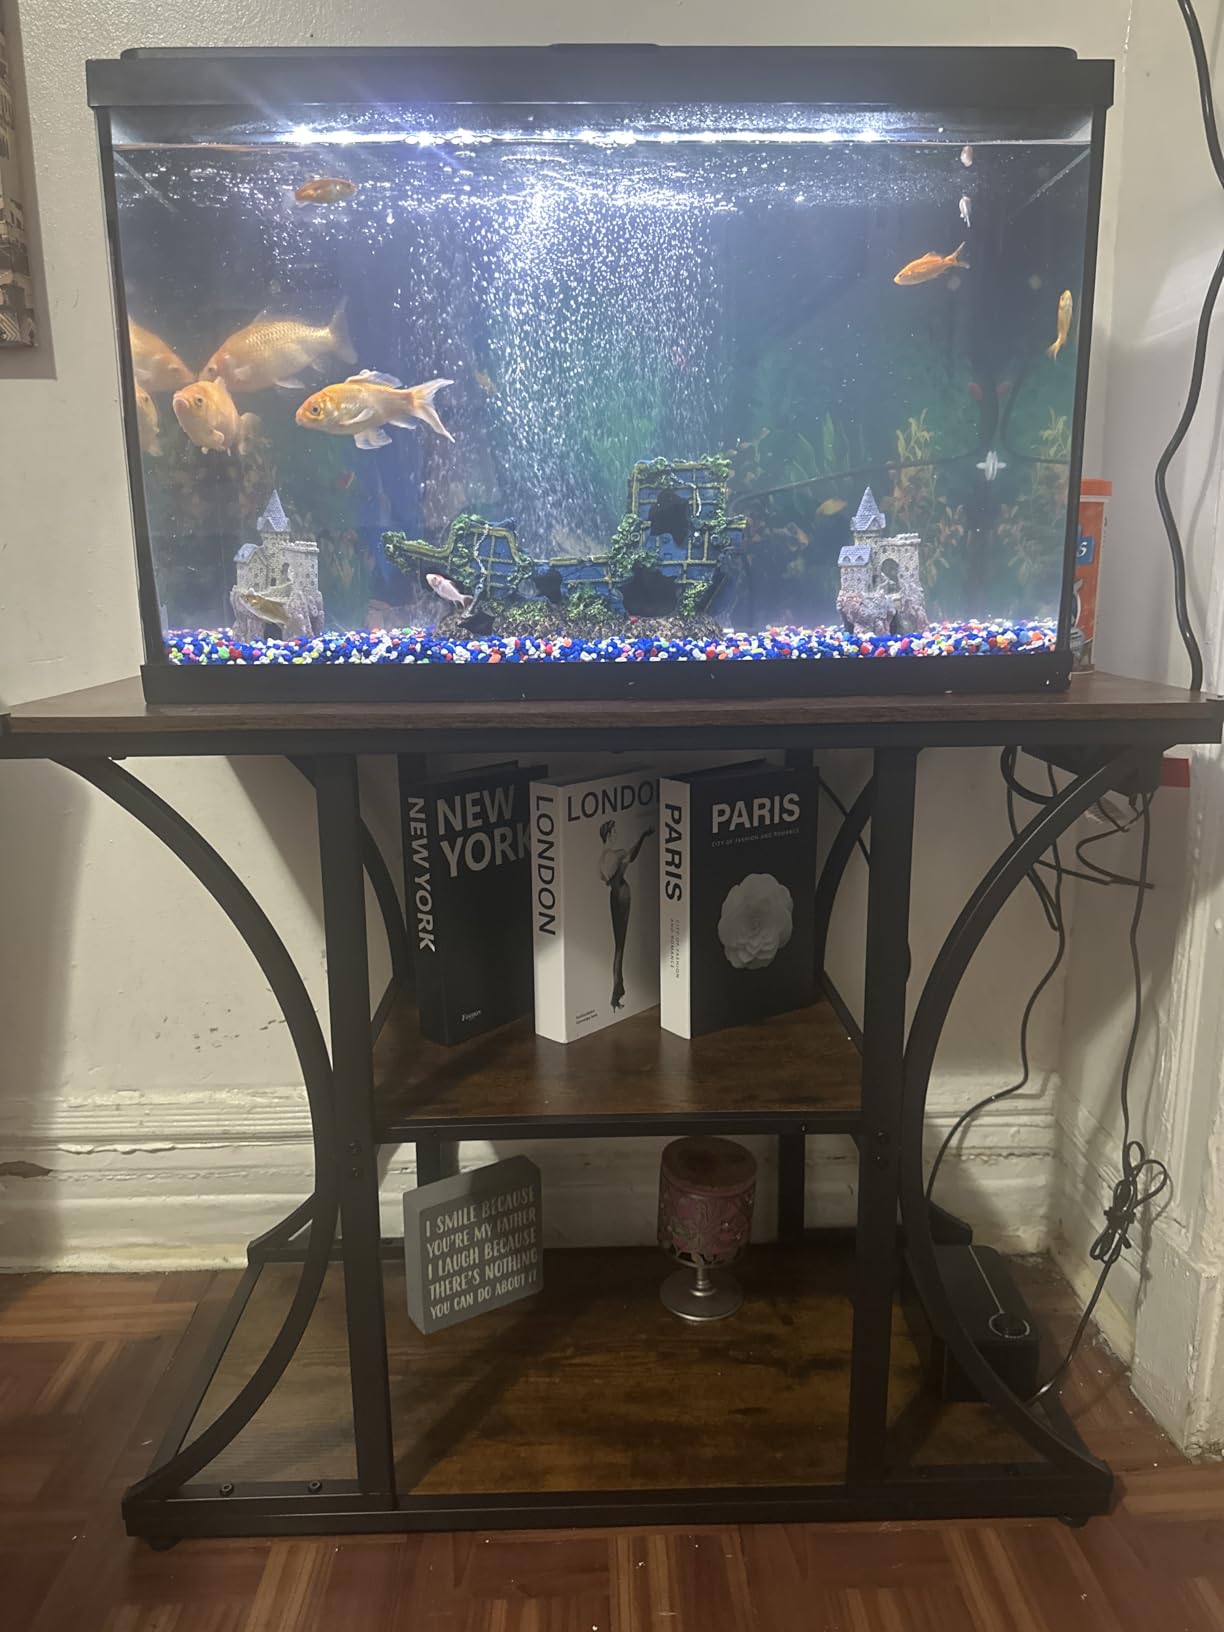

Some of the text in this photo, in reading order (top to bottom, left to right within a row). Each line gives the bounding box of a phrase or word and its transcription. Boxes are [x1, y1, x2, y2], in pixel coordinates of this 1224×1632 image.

[437, 784, 515, 836] NEW
[567, 780, 660, 822] LONDO
[711, 793, 800, 834] PARIS
[407, 797, 436, 952] NEW YORK
[440, 823, 531, 878] YORK
[535, 795, 556, 936] LONDON
[664, 803, 682, 902] PARIS
[426, 1185, 535, 1237] I SMILE BECAUSE
[426, 1207, 536, 1258] YOU'RE MY FATHER
[428, 1227, 537, 1280] I LAUGH BECAUSE
[429, 1248, 538, 1301] THERE'S NOTHING
[430, 1269, 537, 1320] YOU CAN DO ABOUT IT
